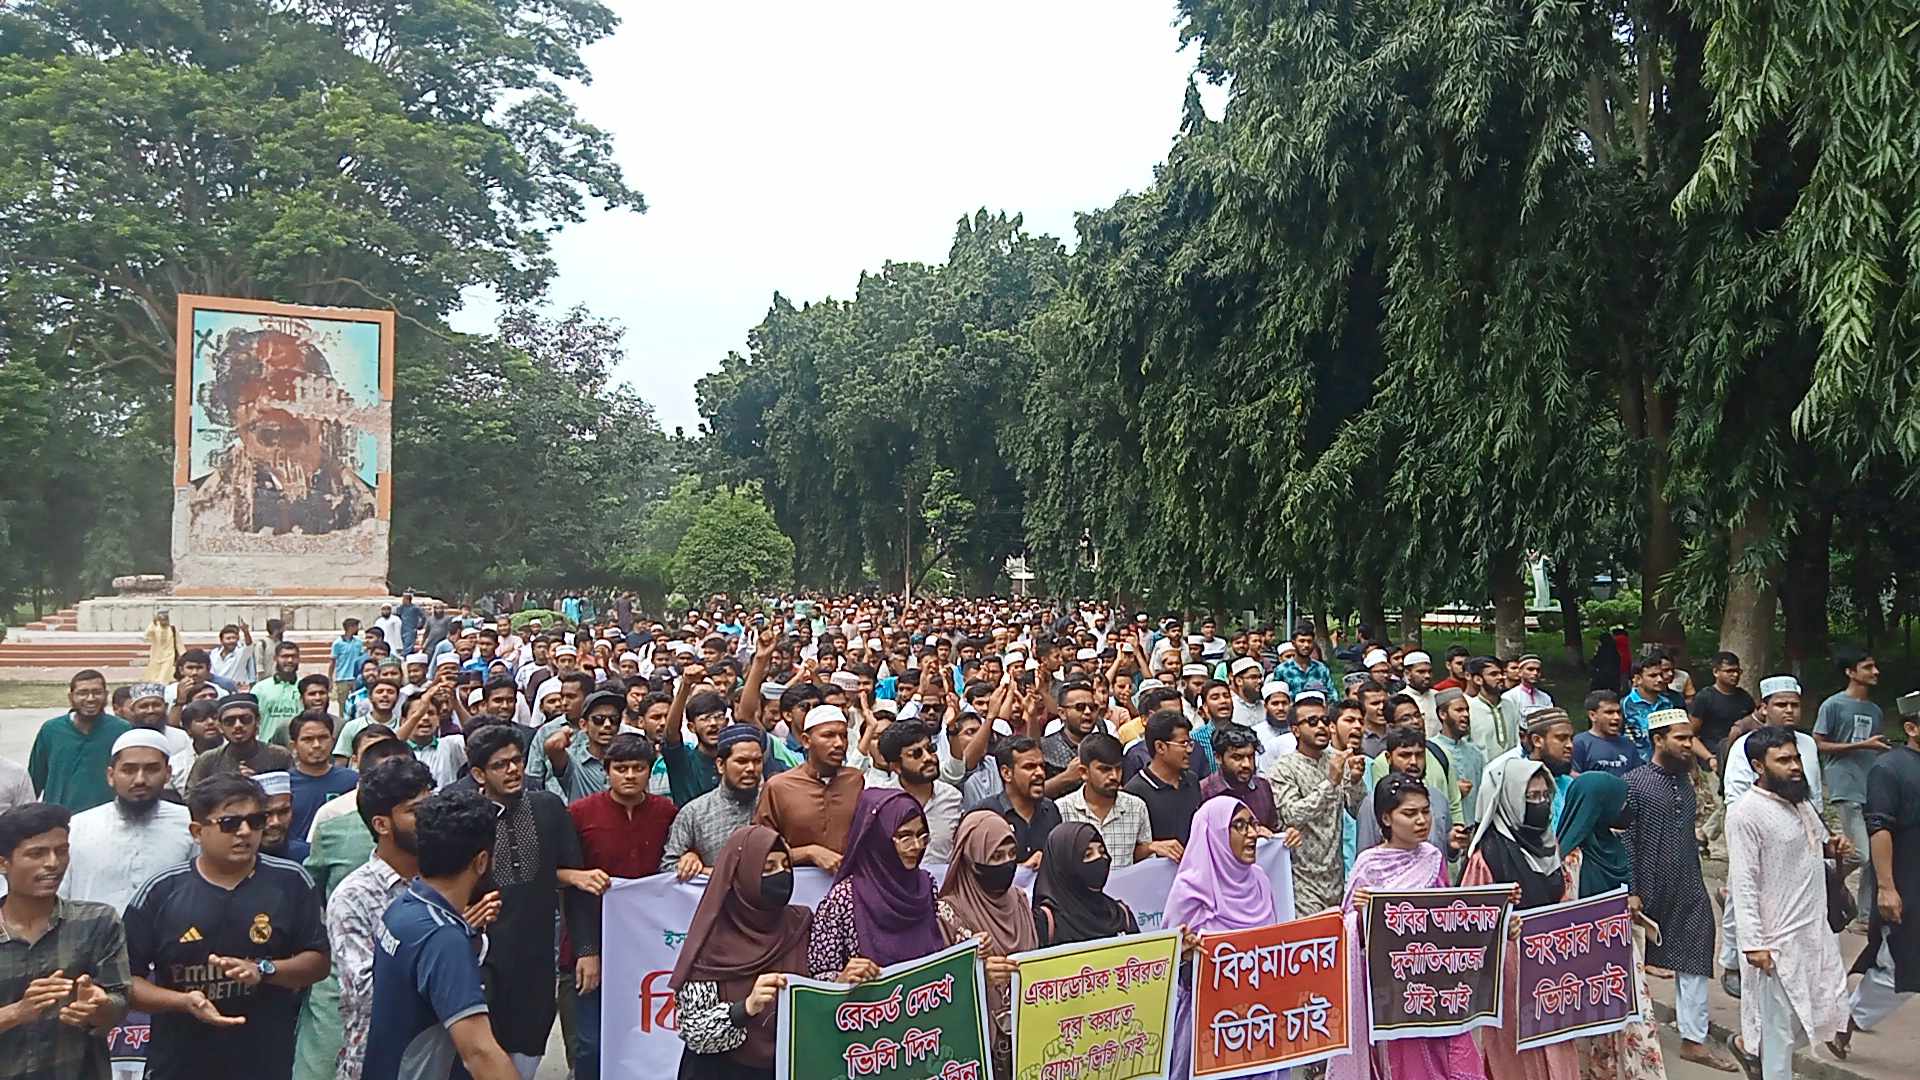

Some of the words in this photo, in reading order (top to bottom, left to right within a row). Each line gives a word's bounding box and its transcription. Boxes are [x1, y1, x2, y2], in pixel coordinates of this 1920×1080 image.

[1384, 901, 1429, 936] ইবির
[1210, 936, 1339, 990] বিশ্বমানের
[1523, 922, 1593, 965] সংস্কার
[836, 984, 903, 1031] রেকর্ড
[906, 973, 954, 1016] দেখে
[1024, 966, 1111, 1005] একাডেমিক
[1439, 981, 1473, 1014] নাই
[1533, 972, 1584, 1021] ভিসি
[1586, 961, 1628, 1005] চাই
[1088, 1004, 1136, 1034] করতে
[1210, 1003, 1277, 1057] ভিসি
[1282, 992, 1332, 1041] চাই
[843, 1038, 900, 1080] ভিসি
[903, 1027, 942, 1065] দিন
